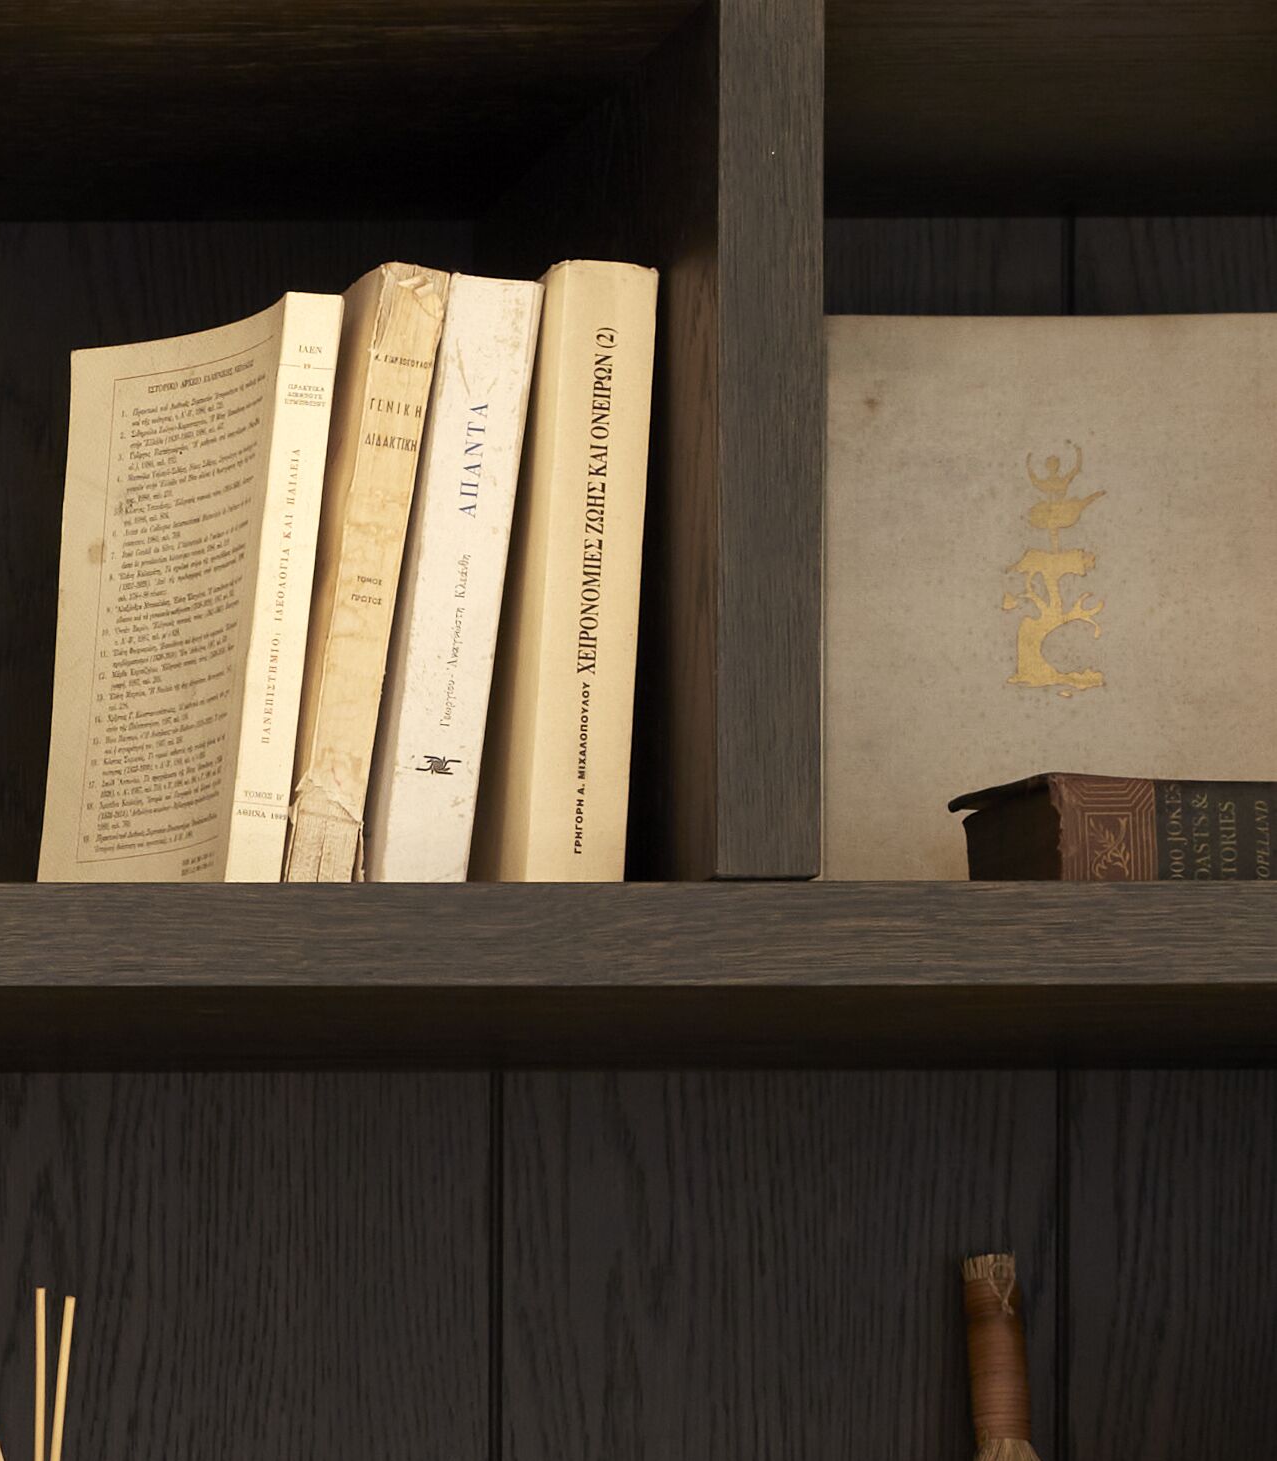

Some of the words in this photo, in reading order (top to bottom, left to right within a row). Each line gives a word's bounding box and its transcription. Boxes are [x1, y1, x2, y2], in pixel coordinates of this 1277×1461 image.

[596, 327, 619, 348] (2)
[370, 398, 422, 418] ΓΕΝΙΚΗ
[590, 354, 613, 440] ΟΝΕΙΡΩΝ
[364, 432, 417, 452] ΔΙΔΑΚΤΙΚΗ
[459, 402, 489, 518] ΑΠΑΝΤΑ
[588, 444, 608, 478] ΚΑΙ
[283, 515, 293, 539] ΚΑΙ
[585, 482, 606, 535] ΖΩΗΣ
[577, 539, 603, 674] ΧΕΙΡΟΝΟΜΙΕΣ
[578, 682, 591, 780] ΜΙΧΑΛΟΠΟΥΛΟΥ
[574, 799, 585, 854] ΓΡΗΓΟΡΗ
[1191, 794, 1208, 809] &
[1219, 801, 1237, 879] TORIES
[1255, 800, 1270, 879] OPELAND
